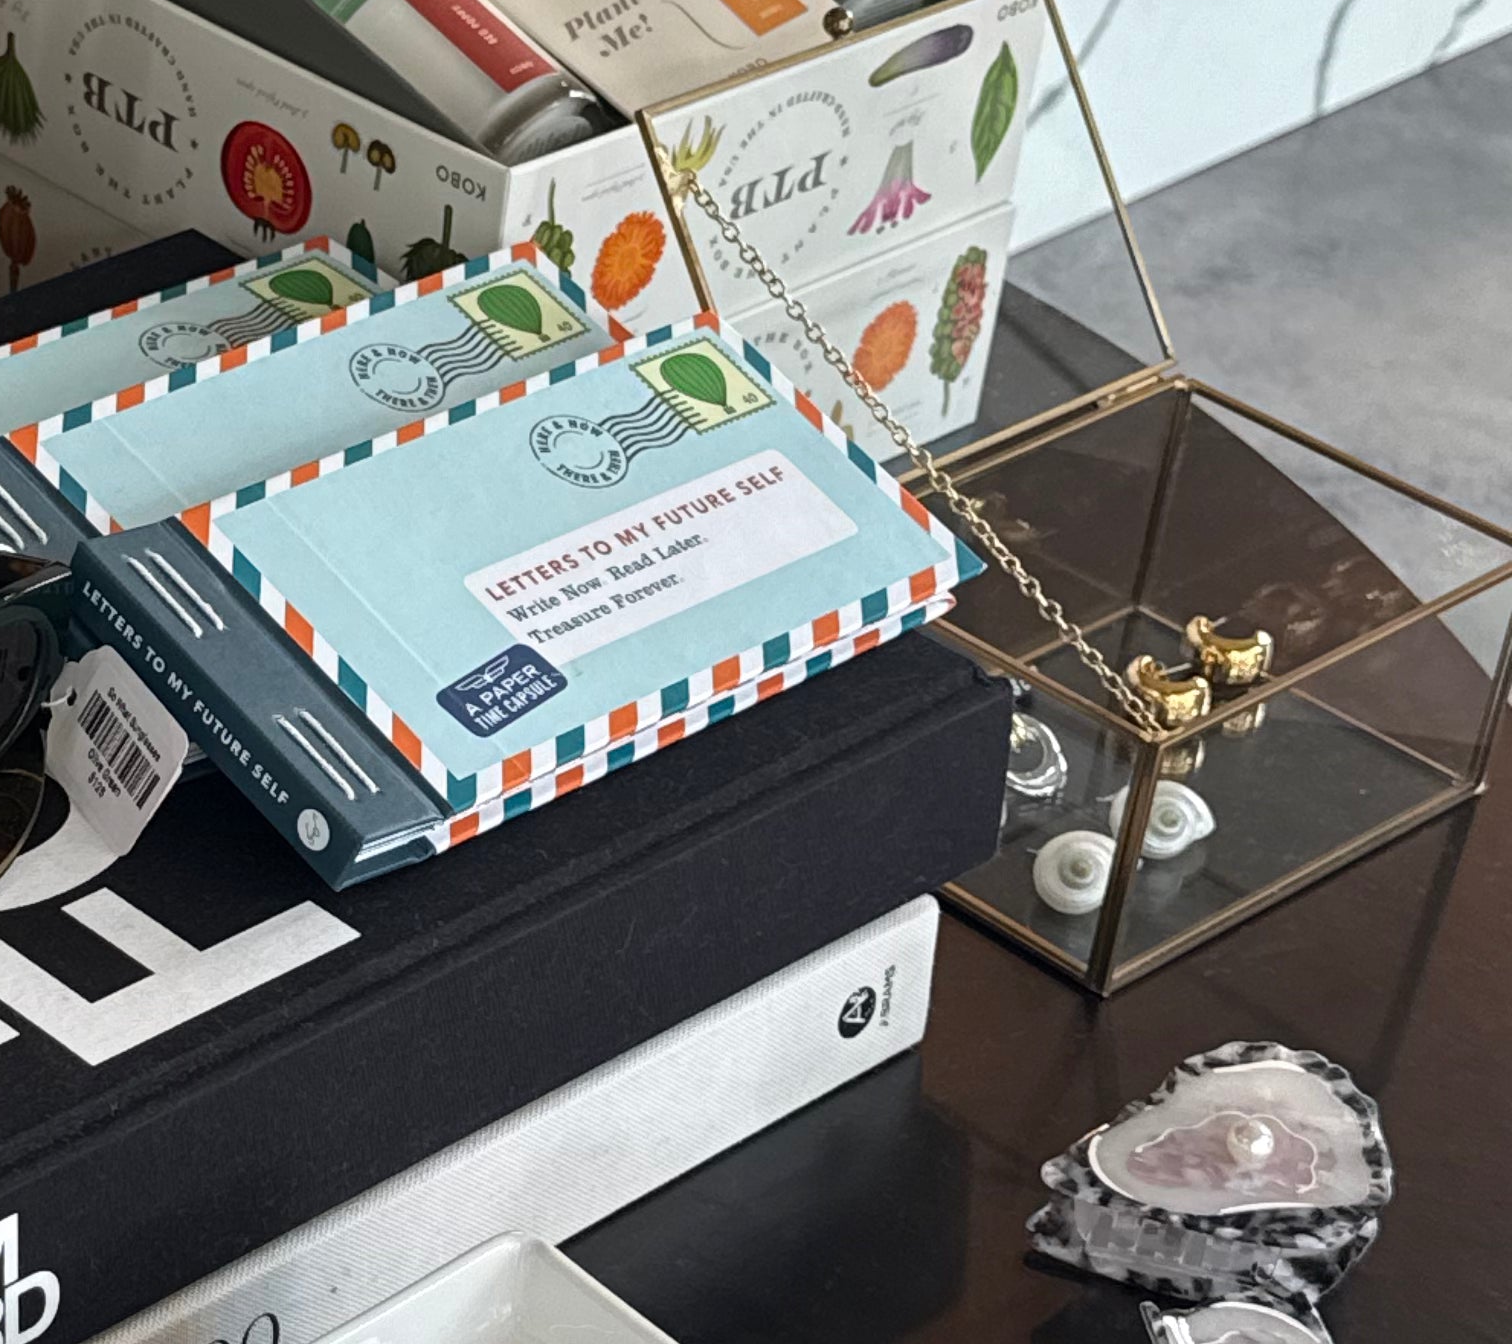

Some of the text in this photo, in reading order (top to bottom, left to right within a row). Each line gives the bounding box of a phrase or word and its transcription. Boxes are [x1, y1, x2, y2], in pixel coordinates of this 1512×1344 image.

[599, 14, 654, 58] Me!
[81, 71, 182, 153] PTB
[435, 164, 487, 202] KOBO
[728, 148, 833, 221] PTB
[355, 347, 422, 380] HERE NOW
[374, 388, 417, 408] THERE
[537, 418, 604, 454] HERE NOW
[555, 463, 600, 484] THERE
[484, 465, 785, 603] LETTERS TO MY FUTURE SELF
[506, 593, 562, 623] Write
[605, 552, 655, 582] Read
[653, 530, 710, 562] Later.
[527, 603, 612, 645] Treasure
[81, 579, 291, 805] LETTERS TO MY FUTURE SELF
[464, 662, 544, 718] A PAPER
[473, 674, 559, 731] TIME CAPSULE
